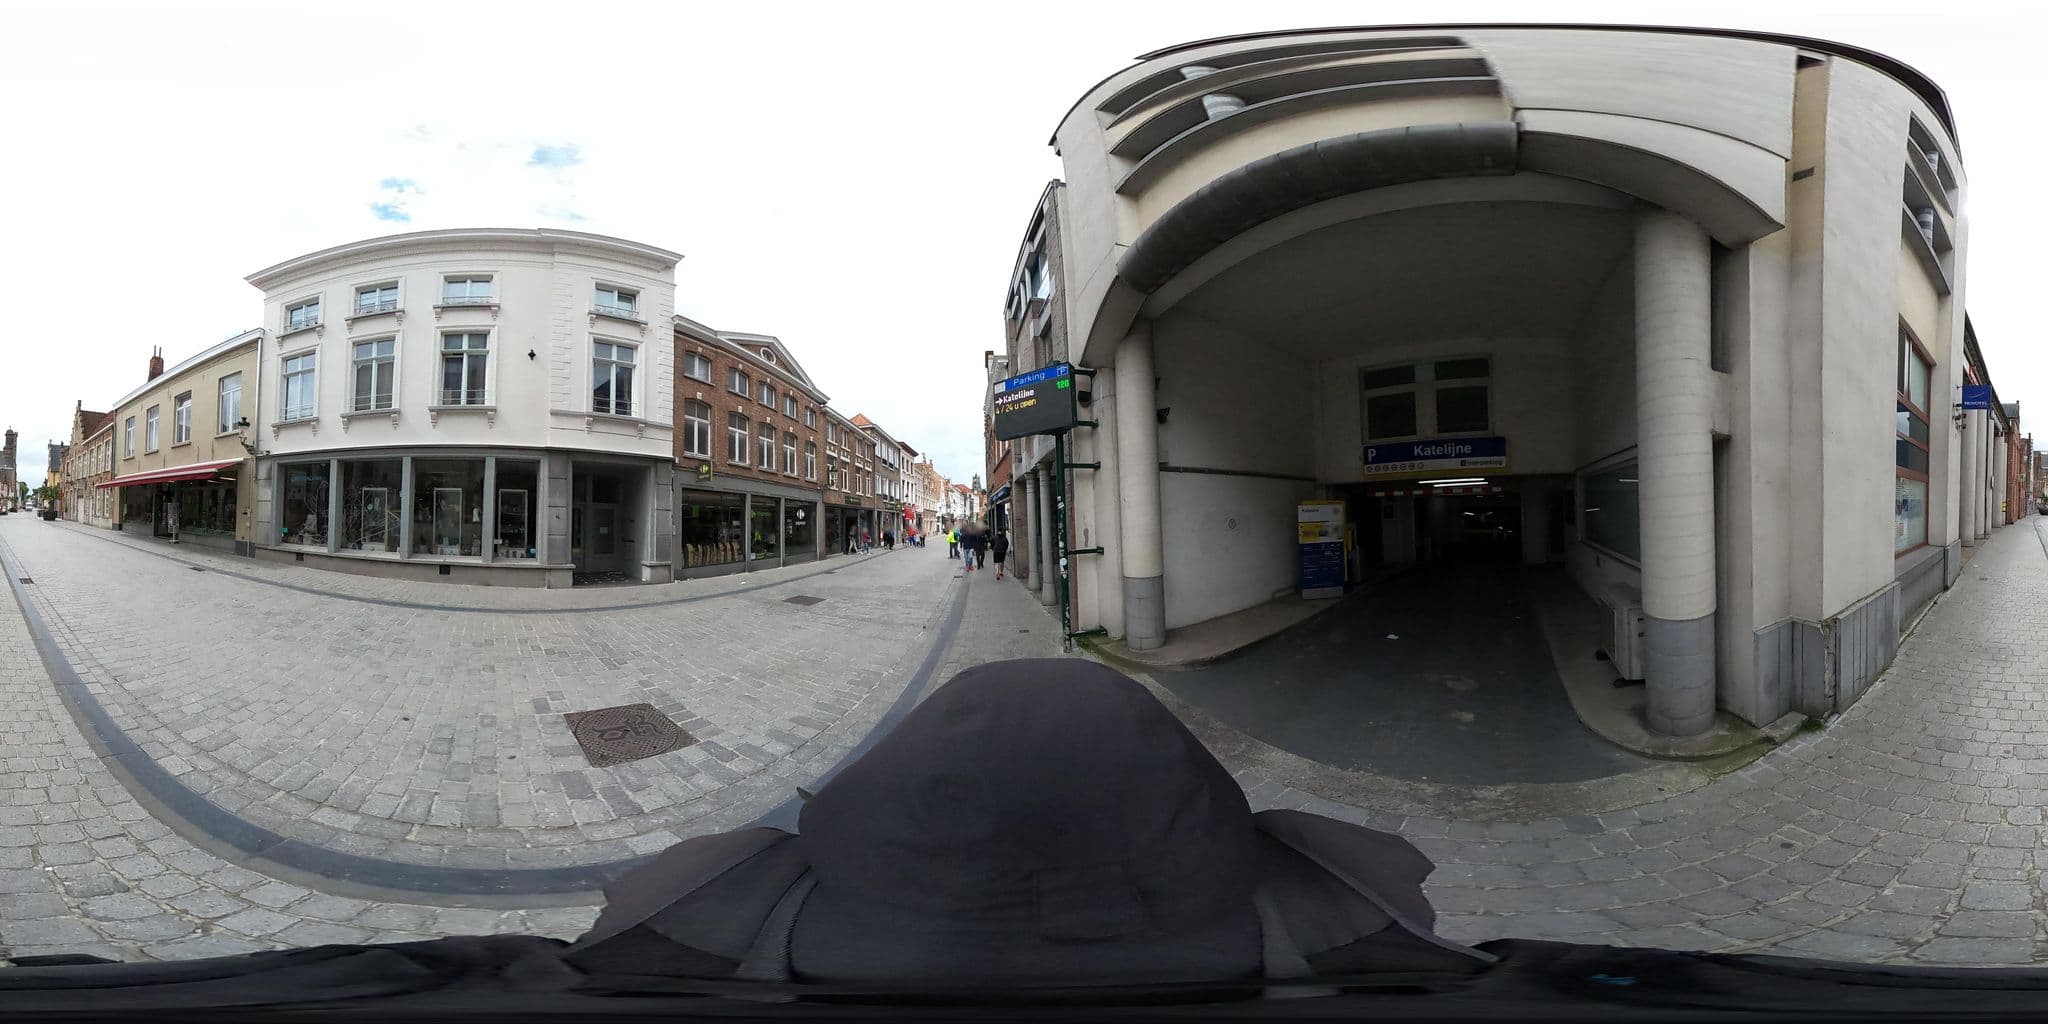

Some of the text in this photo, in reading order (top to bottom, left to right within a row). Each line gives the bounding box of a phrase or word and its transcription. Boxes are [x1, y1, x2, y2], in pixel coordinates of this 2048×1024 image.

[1013, 373, 1045, 387] Parking
[1003, 389, 1035, 404] Katelijne
[1019, 398, 1037, 409] open
[1367, 443, 1472, 463] P Katelijne
